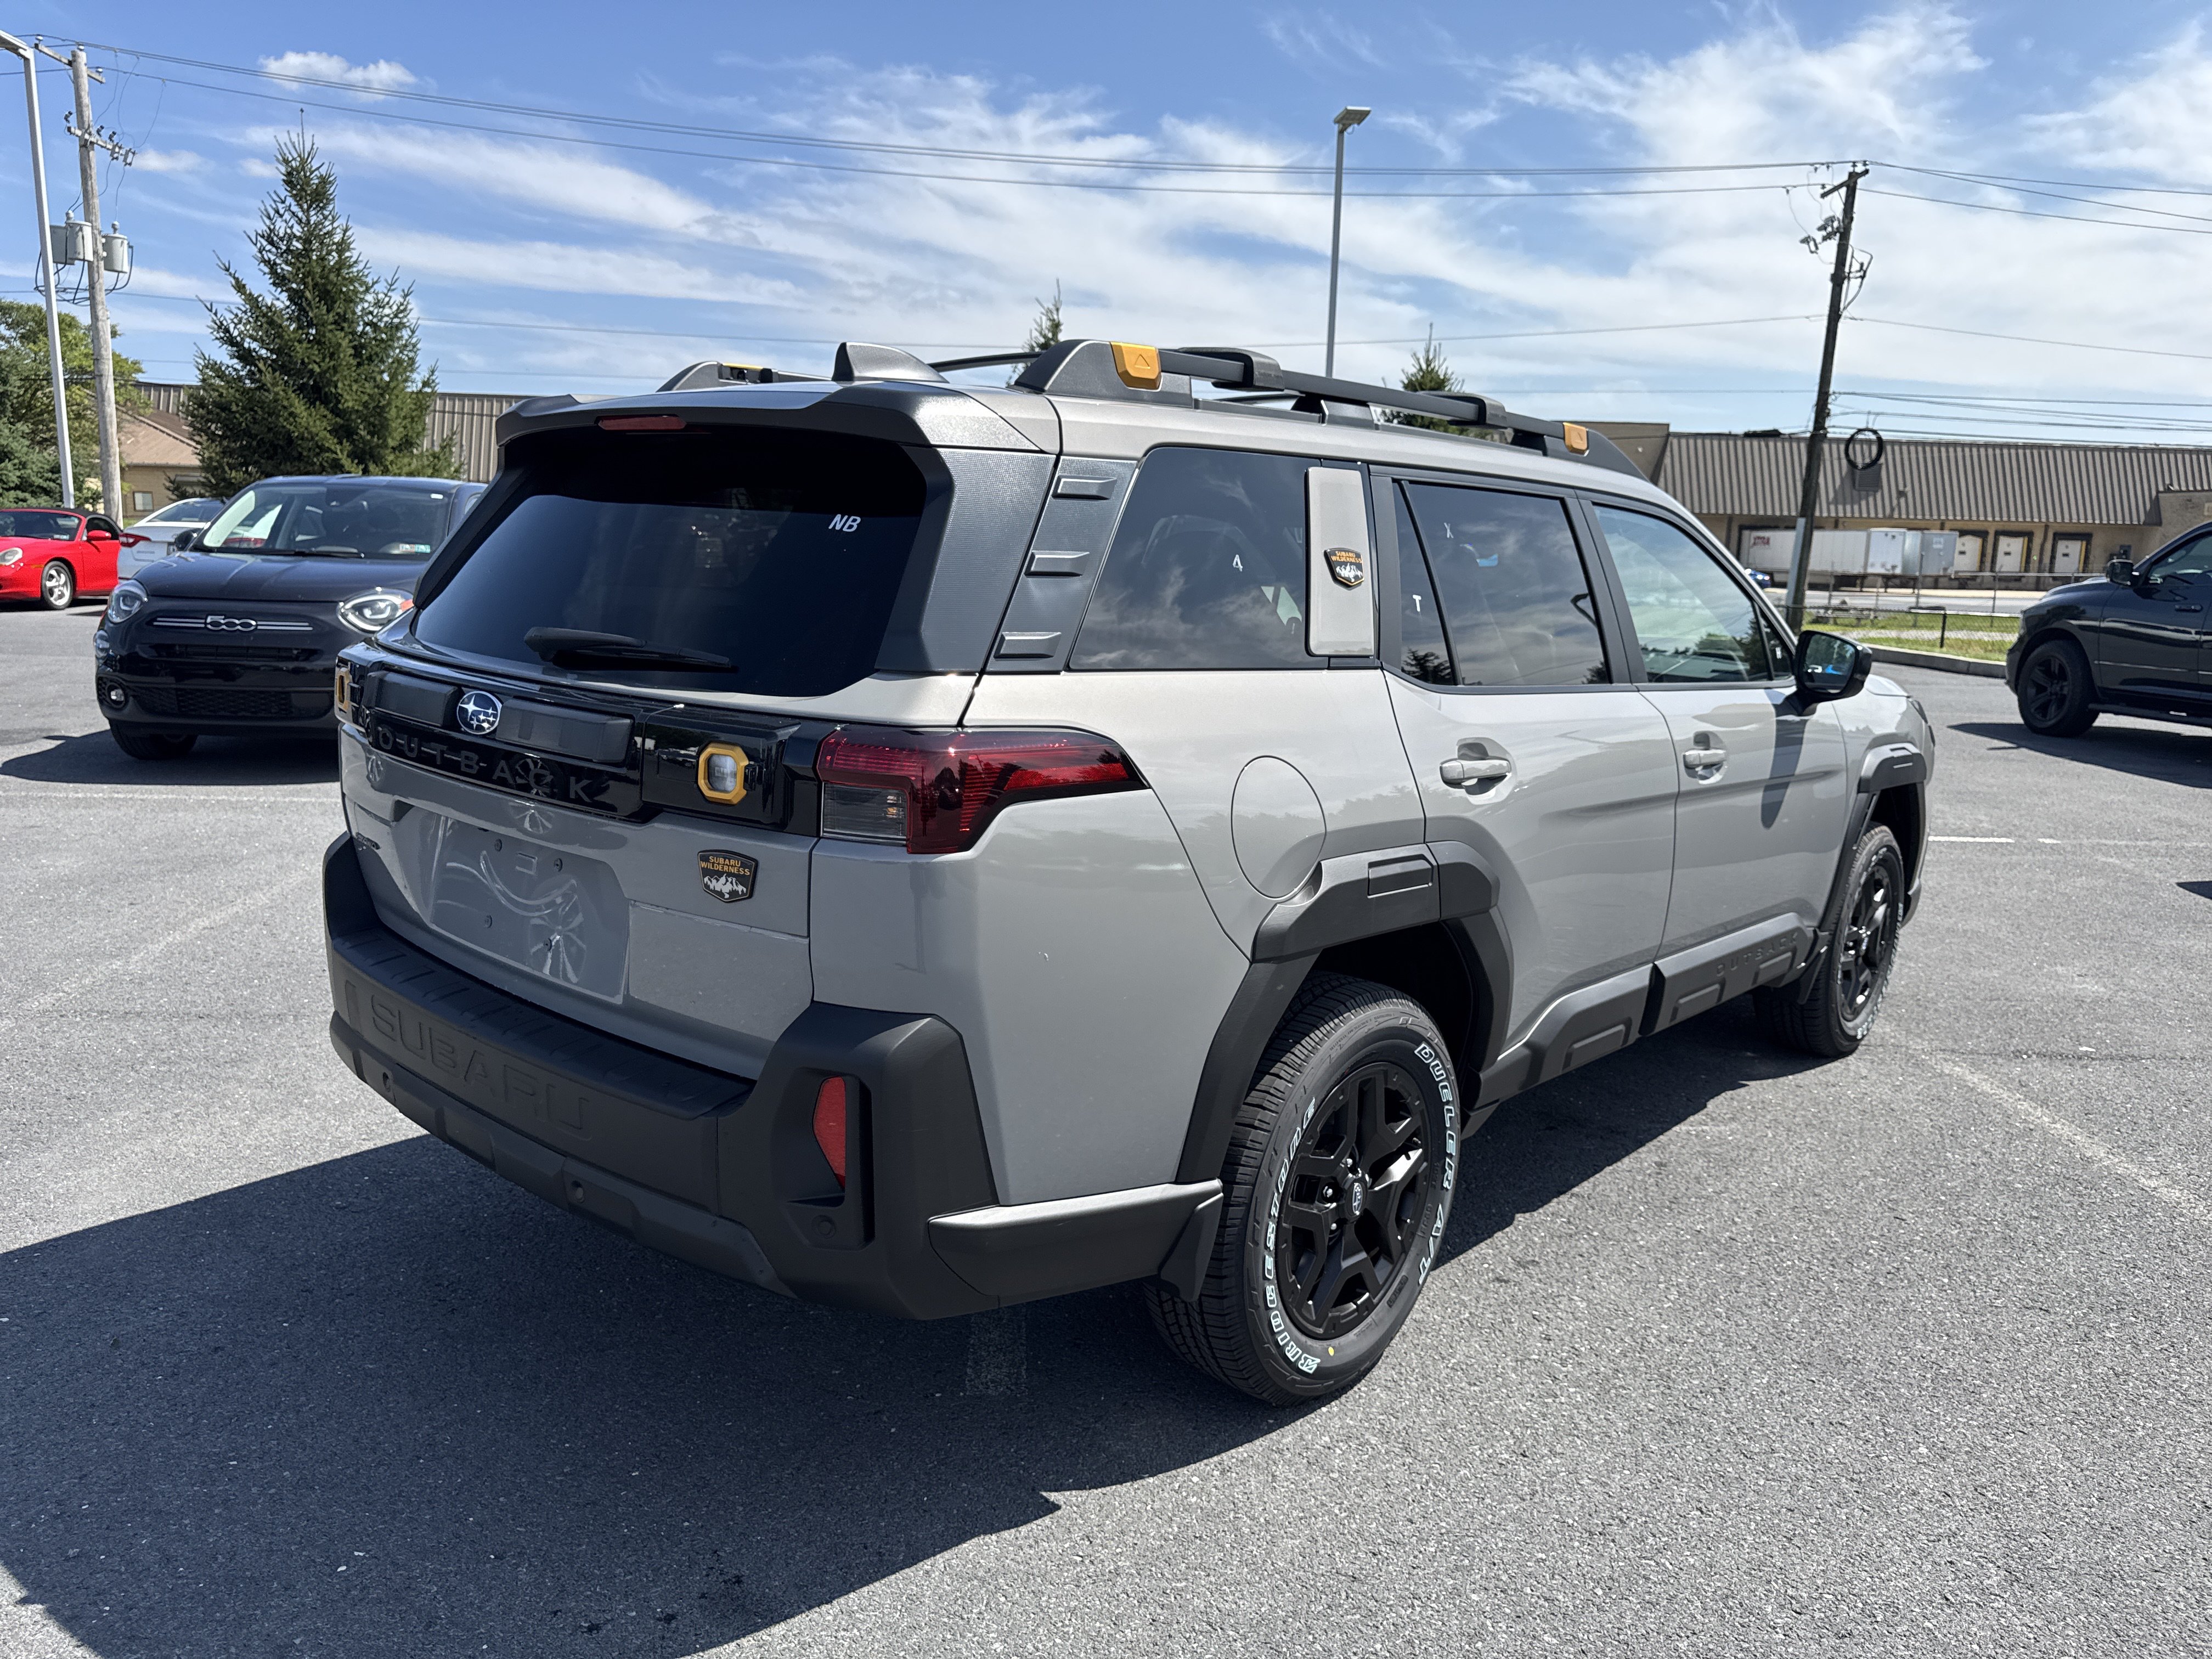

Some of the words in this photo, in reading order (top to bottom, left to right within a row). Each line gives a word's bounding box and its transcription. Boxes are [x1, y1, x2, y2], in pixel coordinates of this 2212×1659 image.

[828, 514, 861, 532] NB
[1232, 554, 1243, 572] 4
[1331, 555, 1362, 563] WILDERNESS
[1412, 594, 1422, 612] T
[206, 615, 257, 631] 500
[379, 727, 593, 803] OUTBACK
[700, 860, 751, 876] WILDERNESS
[709, 855, 741, 867] SUBARU
[371, 994, 594, 1142] SUBARU
[1414, 1042, 1455, 1190] DUELER
[1265, 1097, 1321, 1374] BRIDGESTONE
[1418, 1203, 1444, 1285] A/T
